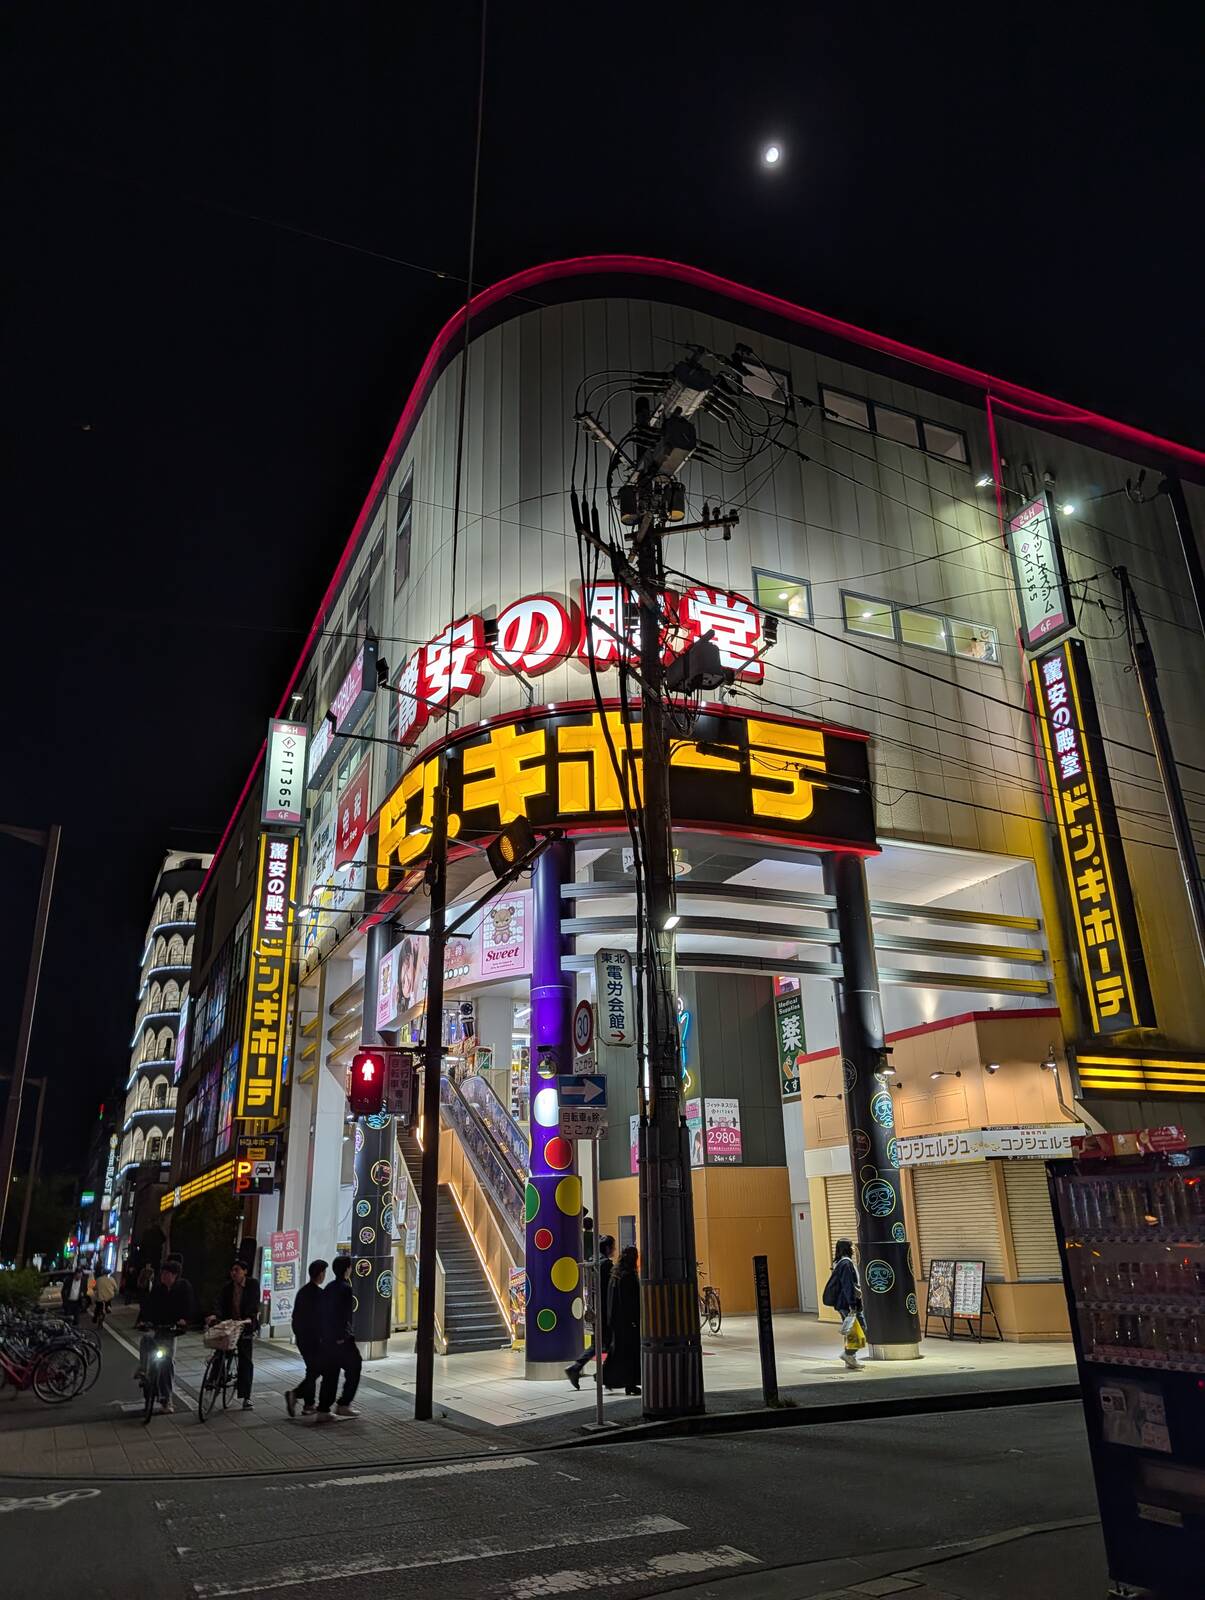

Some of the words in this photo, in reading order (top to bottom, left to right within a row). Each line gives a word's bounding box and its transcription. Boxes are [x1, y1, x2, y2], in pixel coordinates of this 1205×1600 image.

[1019, 508, 1035, 524] 24H
[1030, 518, 1055, 614] フィットネスジム
[1023, 553, 1038, 602] FIT365
[1040, 620, 1052, 633] 4F
[1042, 656, 1082, 780] 驚安の殿堂
[278, 750, 294, 808] FIT365
[264, 841, 289, 931] 驚安の殿堂
[486, 946, 519, 962] Sweet
[601, 953, 626, 964] 東北
[606, 965, 625, 1030] 電労会館
[778, 997, 798, 1007] Medical
[779, 1004, 800, 1015] Supplies
[577, 1014, 588, 1039] 30
[781, 1014, 802, 1052] 薬
[574, 1058, 593, 1073] ここから
[563, 1125, 604, 1135] ここから
[897, 1136, 970, 1160] コンシェルジュ
[238, 1161, 251, 1178] P
